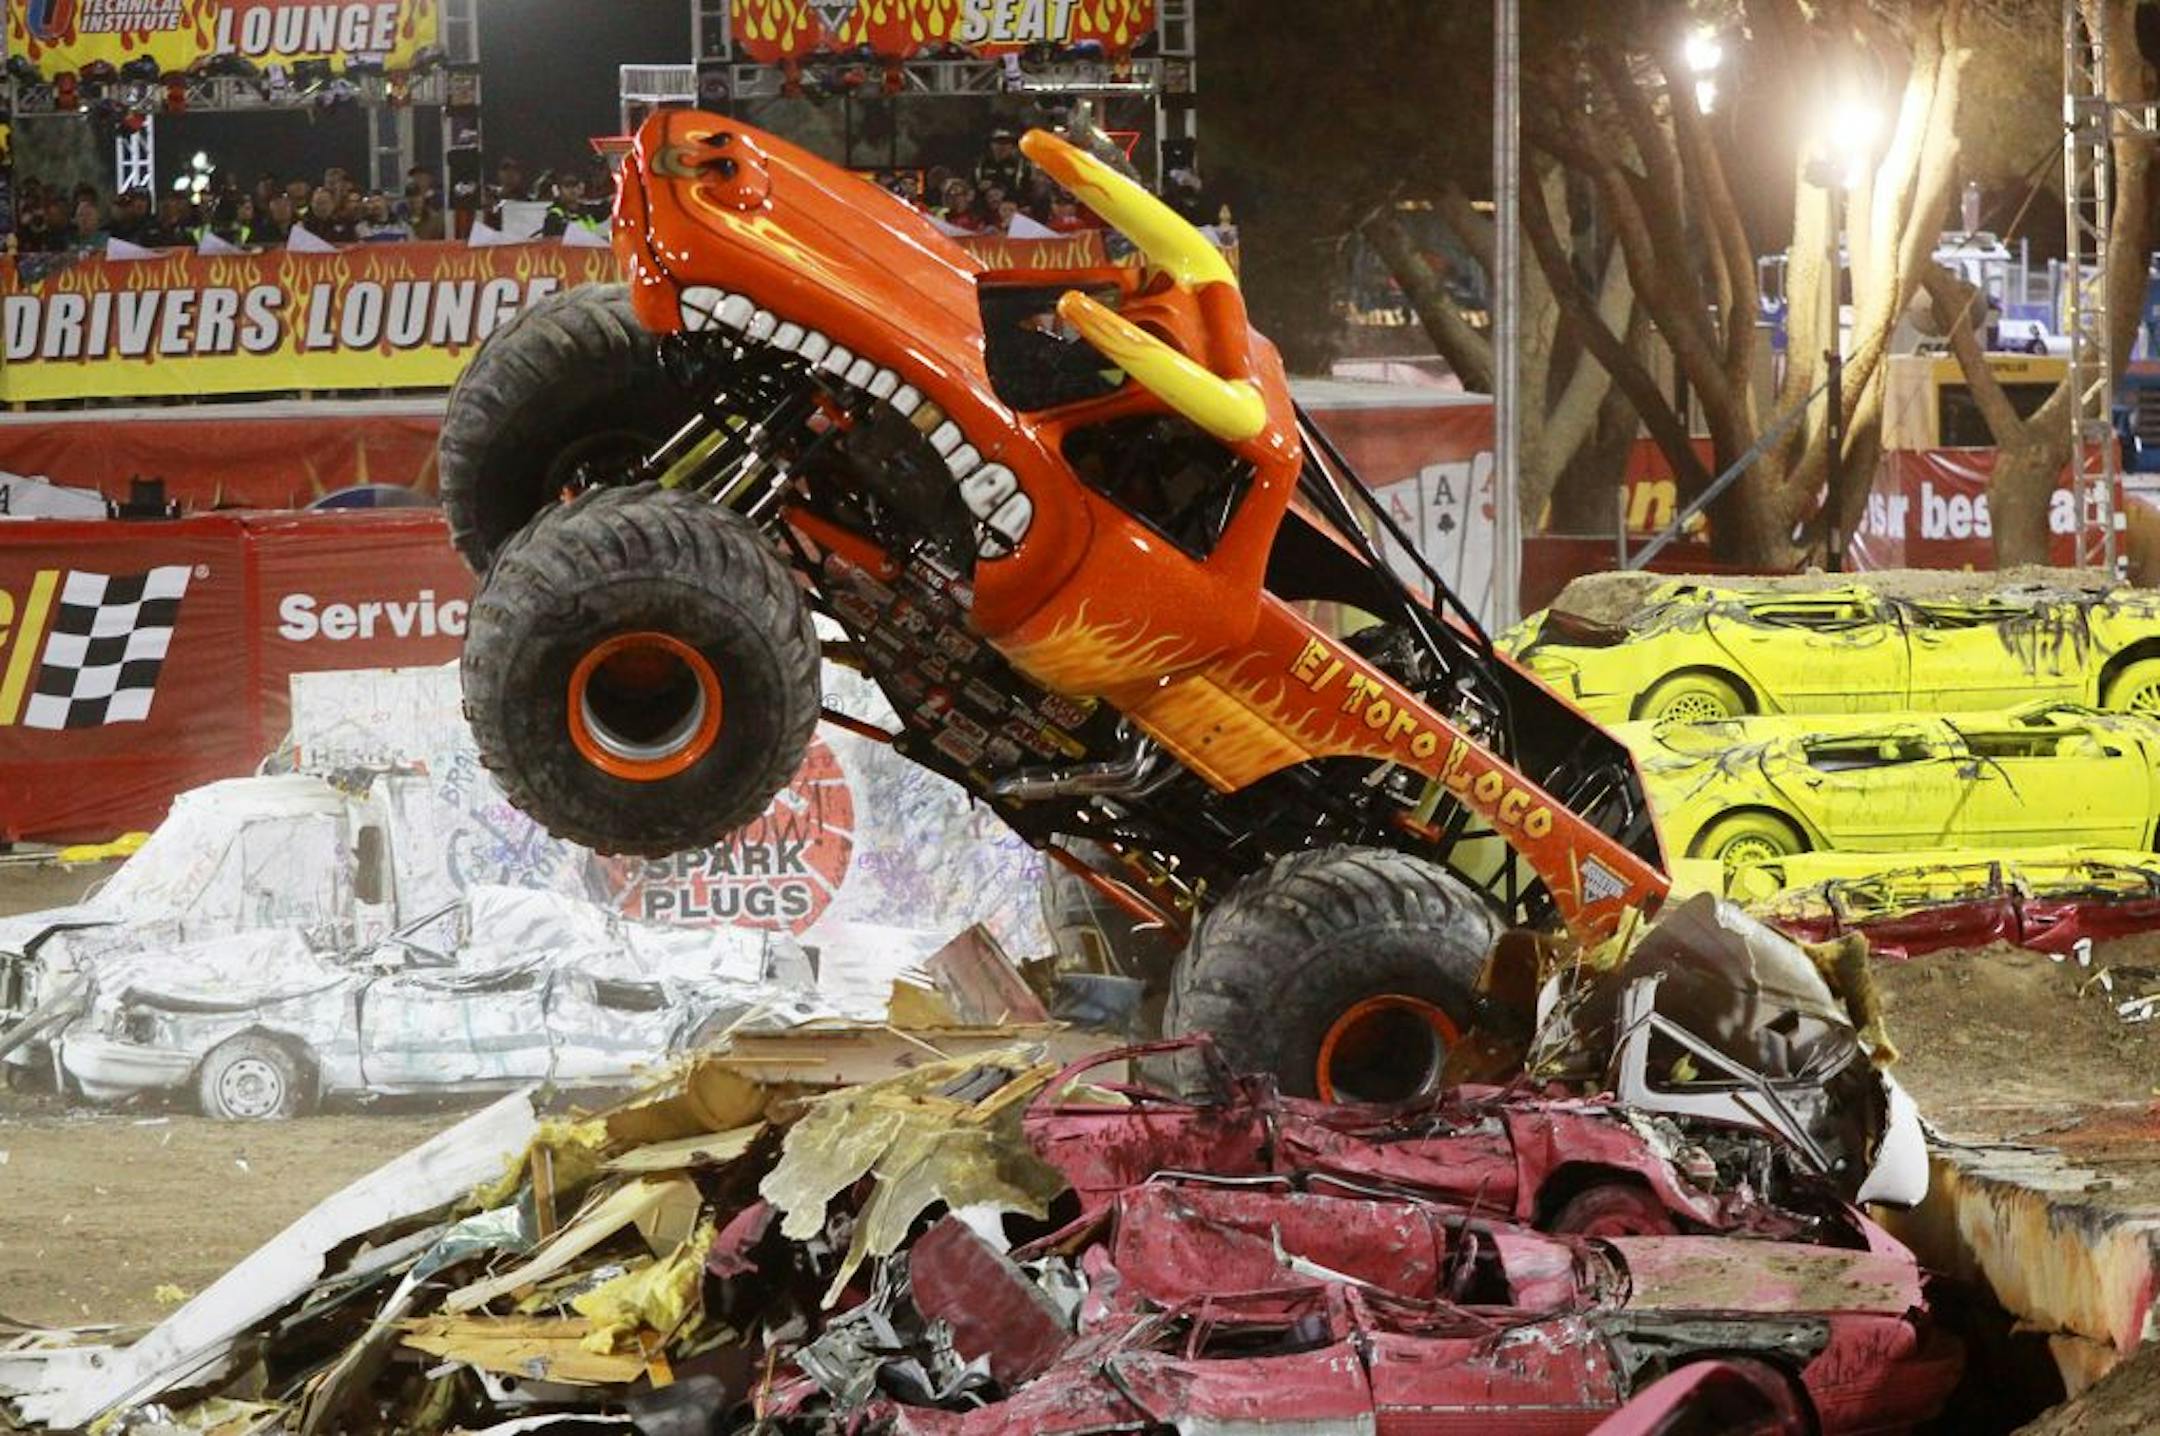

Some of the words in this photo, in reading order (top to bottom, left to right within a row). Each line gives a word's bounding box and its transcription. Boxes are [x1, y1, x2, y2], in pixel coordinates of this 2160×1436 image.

[80, 13, 180, 32] INSTITUTE
[83, 0, 183, 13] TECHNICAL
[963, 0, 1078, 42] SEAT
[215, 3, 396, 54] LOUNGE
[4, 285, 283, 361] DRIVERS
[1433, 475, 1456, 506] A
[643, 842, 807, 880] SPARK
[644, 885, 809, 919] PLUGS
